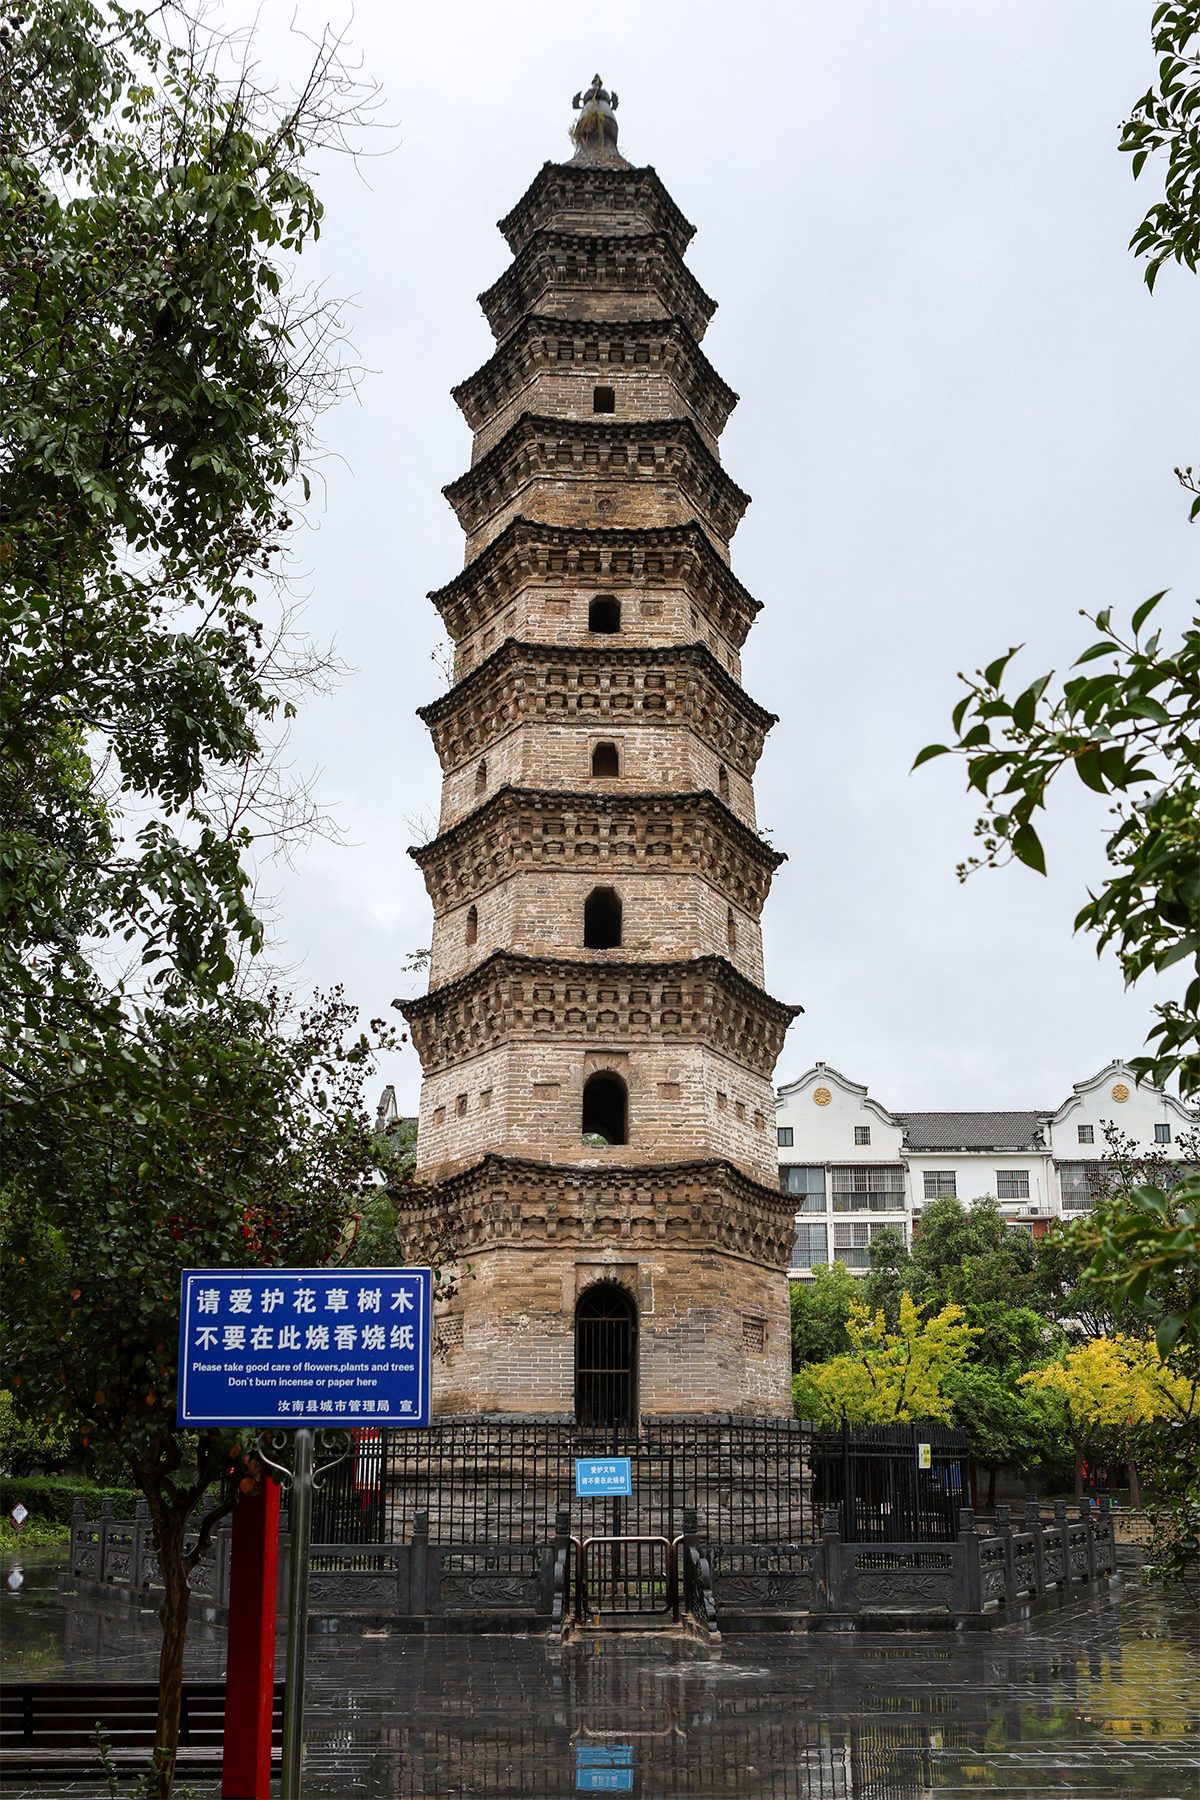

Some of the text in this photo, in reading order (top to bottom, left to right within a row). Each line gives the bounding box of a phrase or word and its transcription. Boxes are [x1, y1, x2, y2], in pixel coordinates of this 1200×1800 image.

[196, 1288, 415, 1314] 请爱护花草树木
[194, 1325, 415, 1351] 不要在此烧香烧纸
[192, 1362, 222, 1372] Please
[224, 1362, 244, 1372] take
[245, 1362, 270, 1373] good
[271, 1364, 291, 1372] care
[292, 1362, 303, 1372] of
[371, 1362, 389, 1372] and
[391, 1363, 415, 1372] trees
[228, 1377, 378, 1388] Don't burn incense or paper here
[277, 1399, 413, 1413] 汝南县城市管理局 宣
